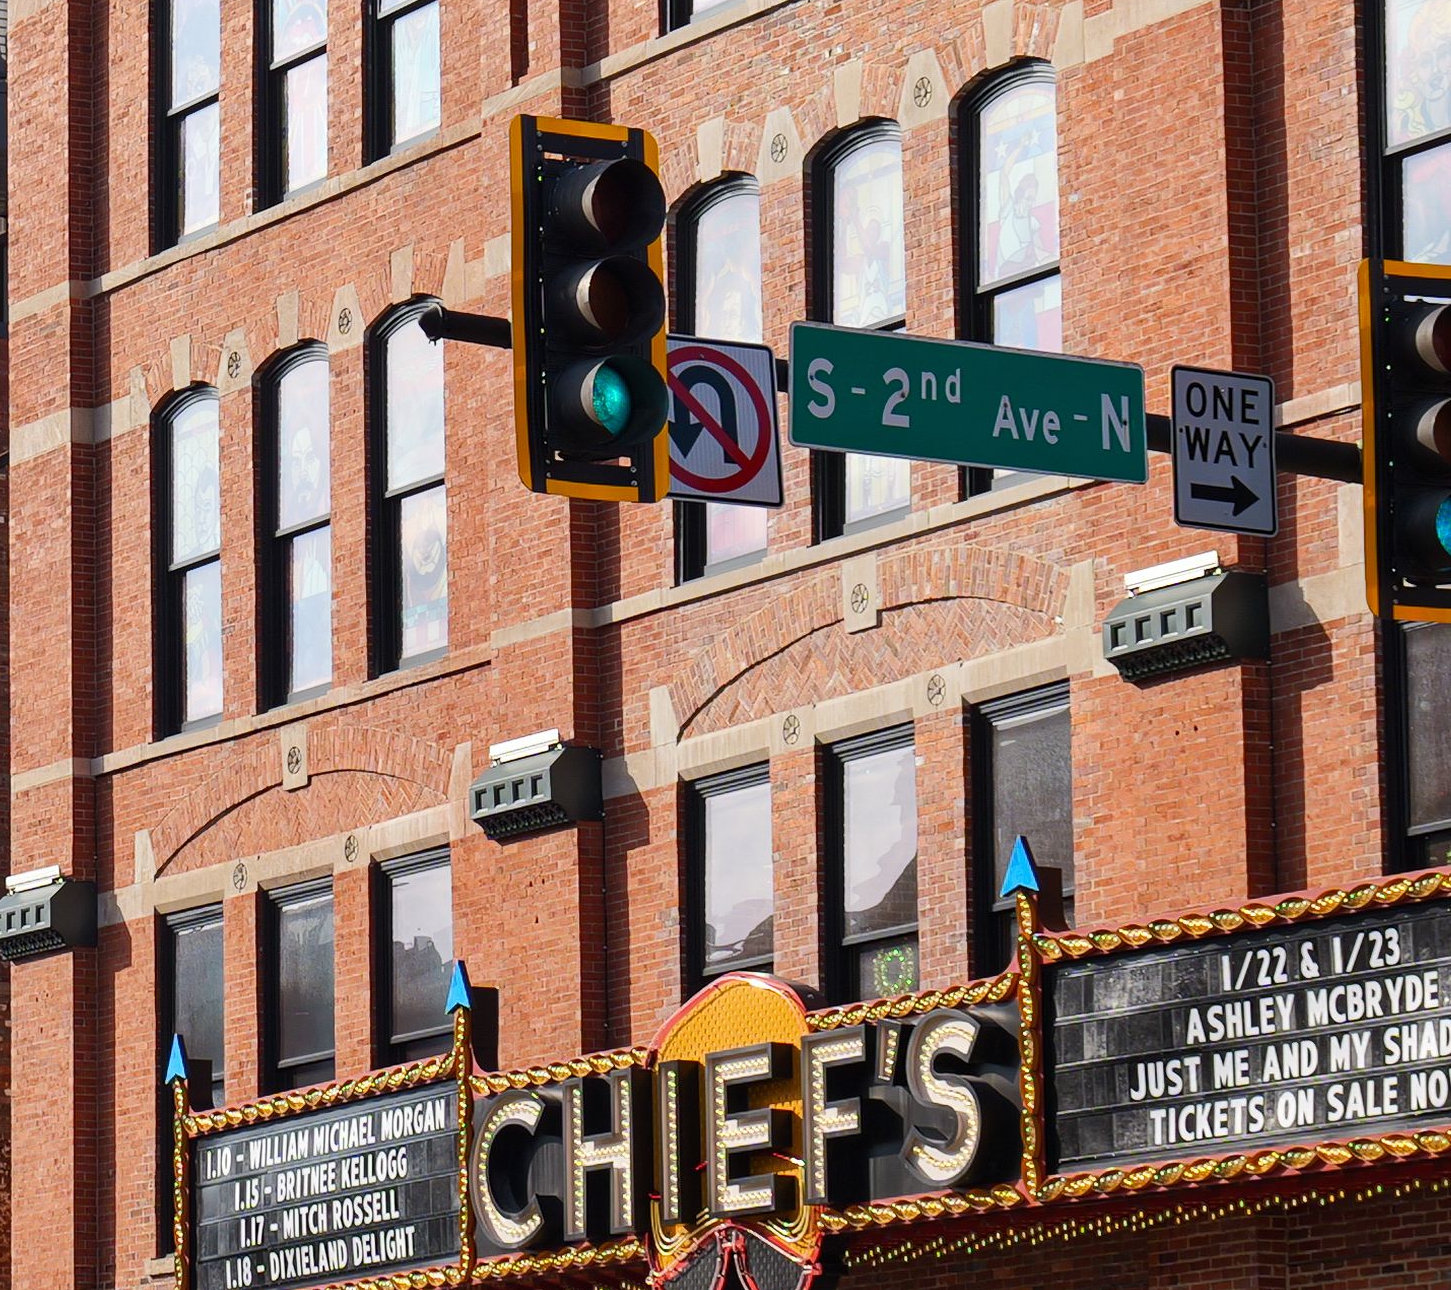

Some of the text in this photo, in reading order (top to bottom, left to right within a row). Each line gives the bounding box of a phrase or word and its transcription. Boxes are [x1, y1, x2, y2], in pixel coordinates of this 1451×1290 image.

[992, 394, 1061, 445] Ave
[1185, 381, 1260, 426] ONE
[1183, 426, 1264, 470] WAY
[1221, 926, 1401, 992] 1/22 & 1/23
[1185, 970, 1439, 1046] ASHLEY MCBRYDE
[1129, 1055, 1201, 1103] JUST
[1213, 1048, 1250, 1090] ME
[1263, 1039, 1319, 1081] AND
[1329, 1031, 1371, 1074] MY
[248, 1134, 308, 1171] WILLIAM
[312, 1114, 376, 1157] MICHAEL
[380, 1098, 446, 1141] MORGAN
[471, 1006, 985, 1252] CHIEF'S
[1150, 1096, 1266, 1147] TICKETS
[1278, 1089, 1314, 1128] ON
[1326, 1076, 1399, 1124] SALE
[276, 1162, 337, 1203] BRITNEE
[341, 1146, 408, 1190] KELLOGG
[282, 1202, 328, 1240] MITCH
[332, 1189, 400, 1231] ROSSELL
[269, 1237, 348, 1282] DIXIELAND
[352, 1225, 416, 1268] DELIGHT
